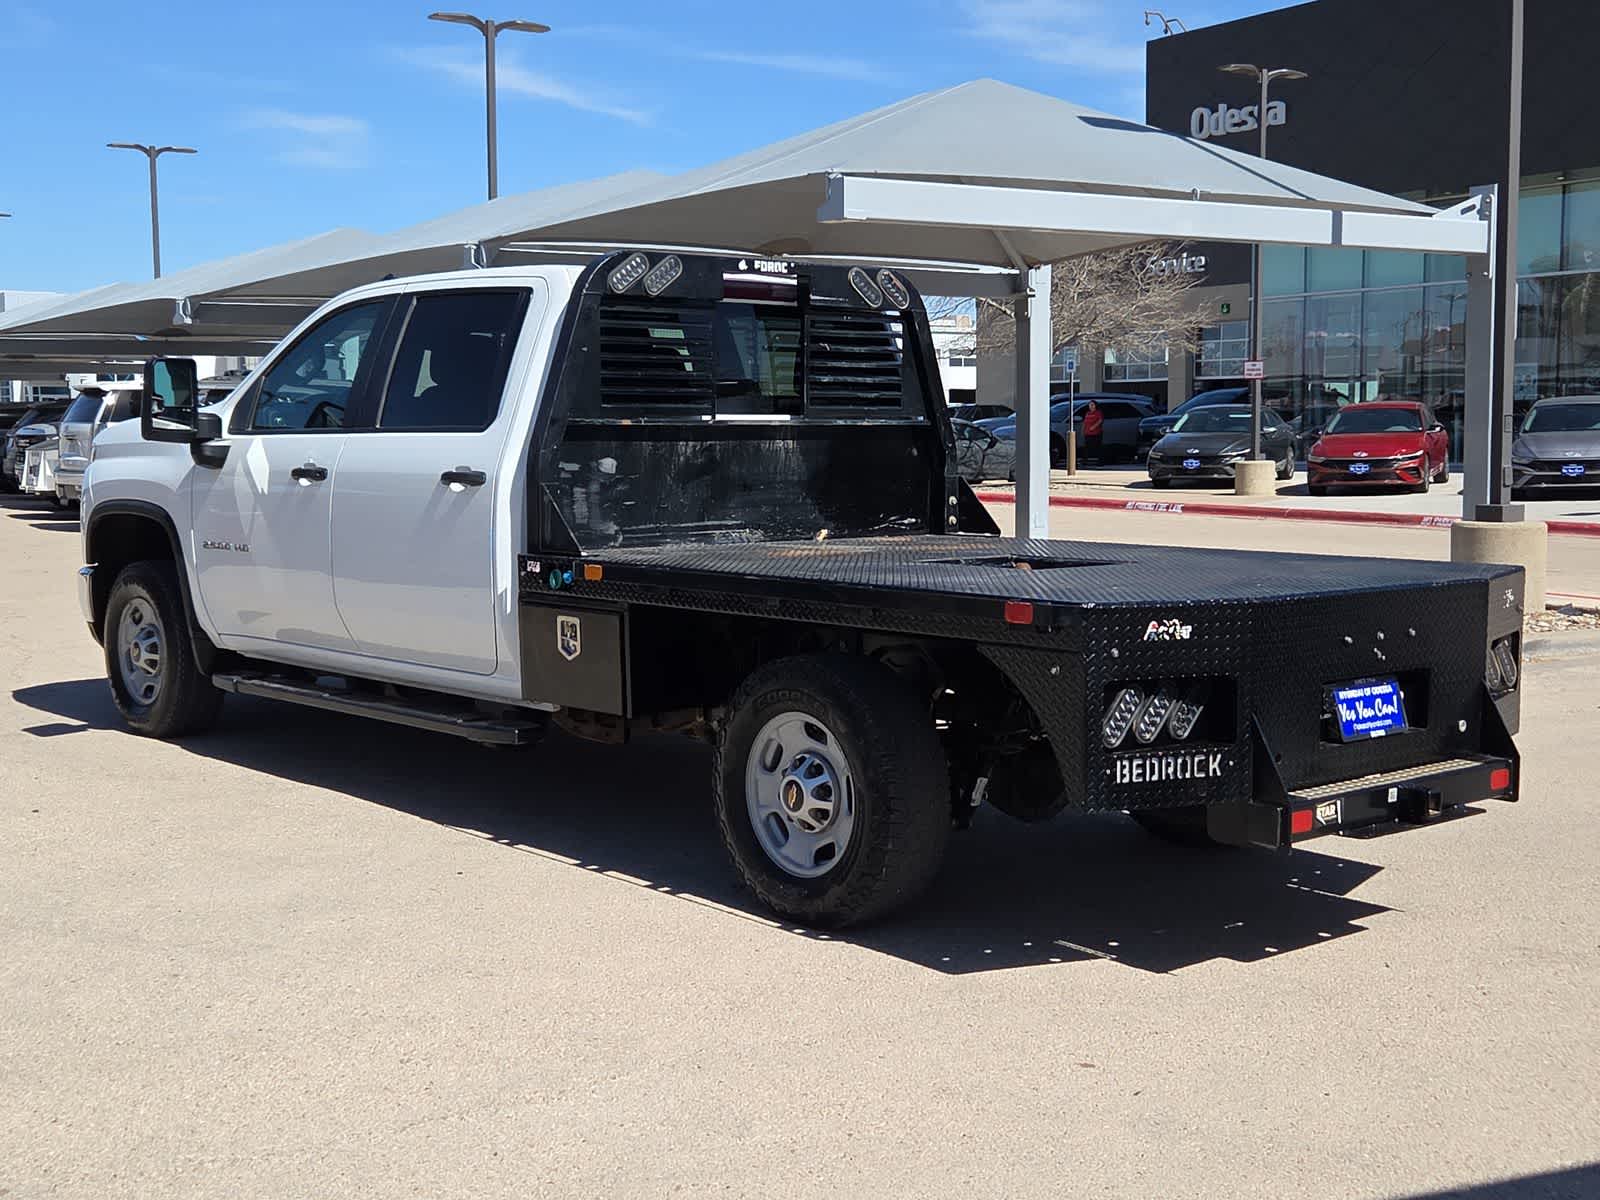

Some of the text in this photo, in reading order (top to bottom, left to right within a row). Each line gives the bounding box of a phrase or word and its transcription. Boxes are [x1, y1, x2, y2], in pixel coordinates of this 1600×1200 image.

[1337, 694, 1399, 723] Yes You Can!
[1116, 753, 1221, 784] BEDROCK
